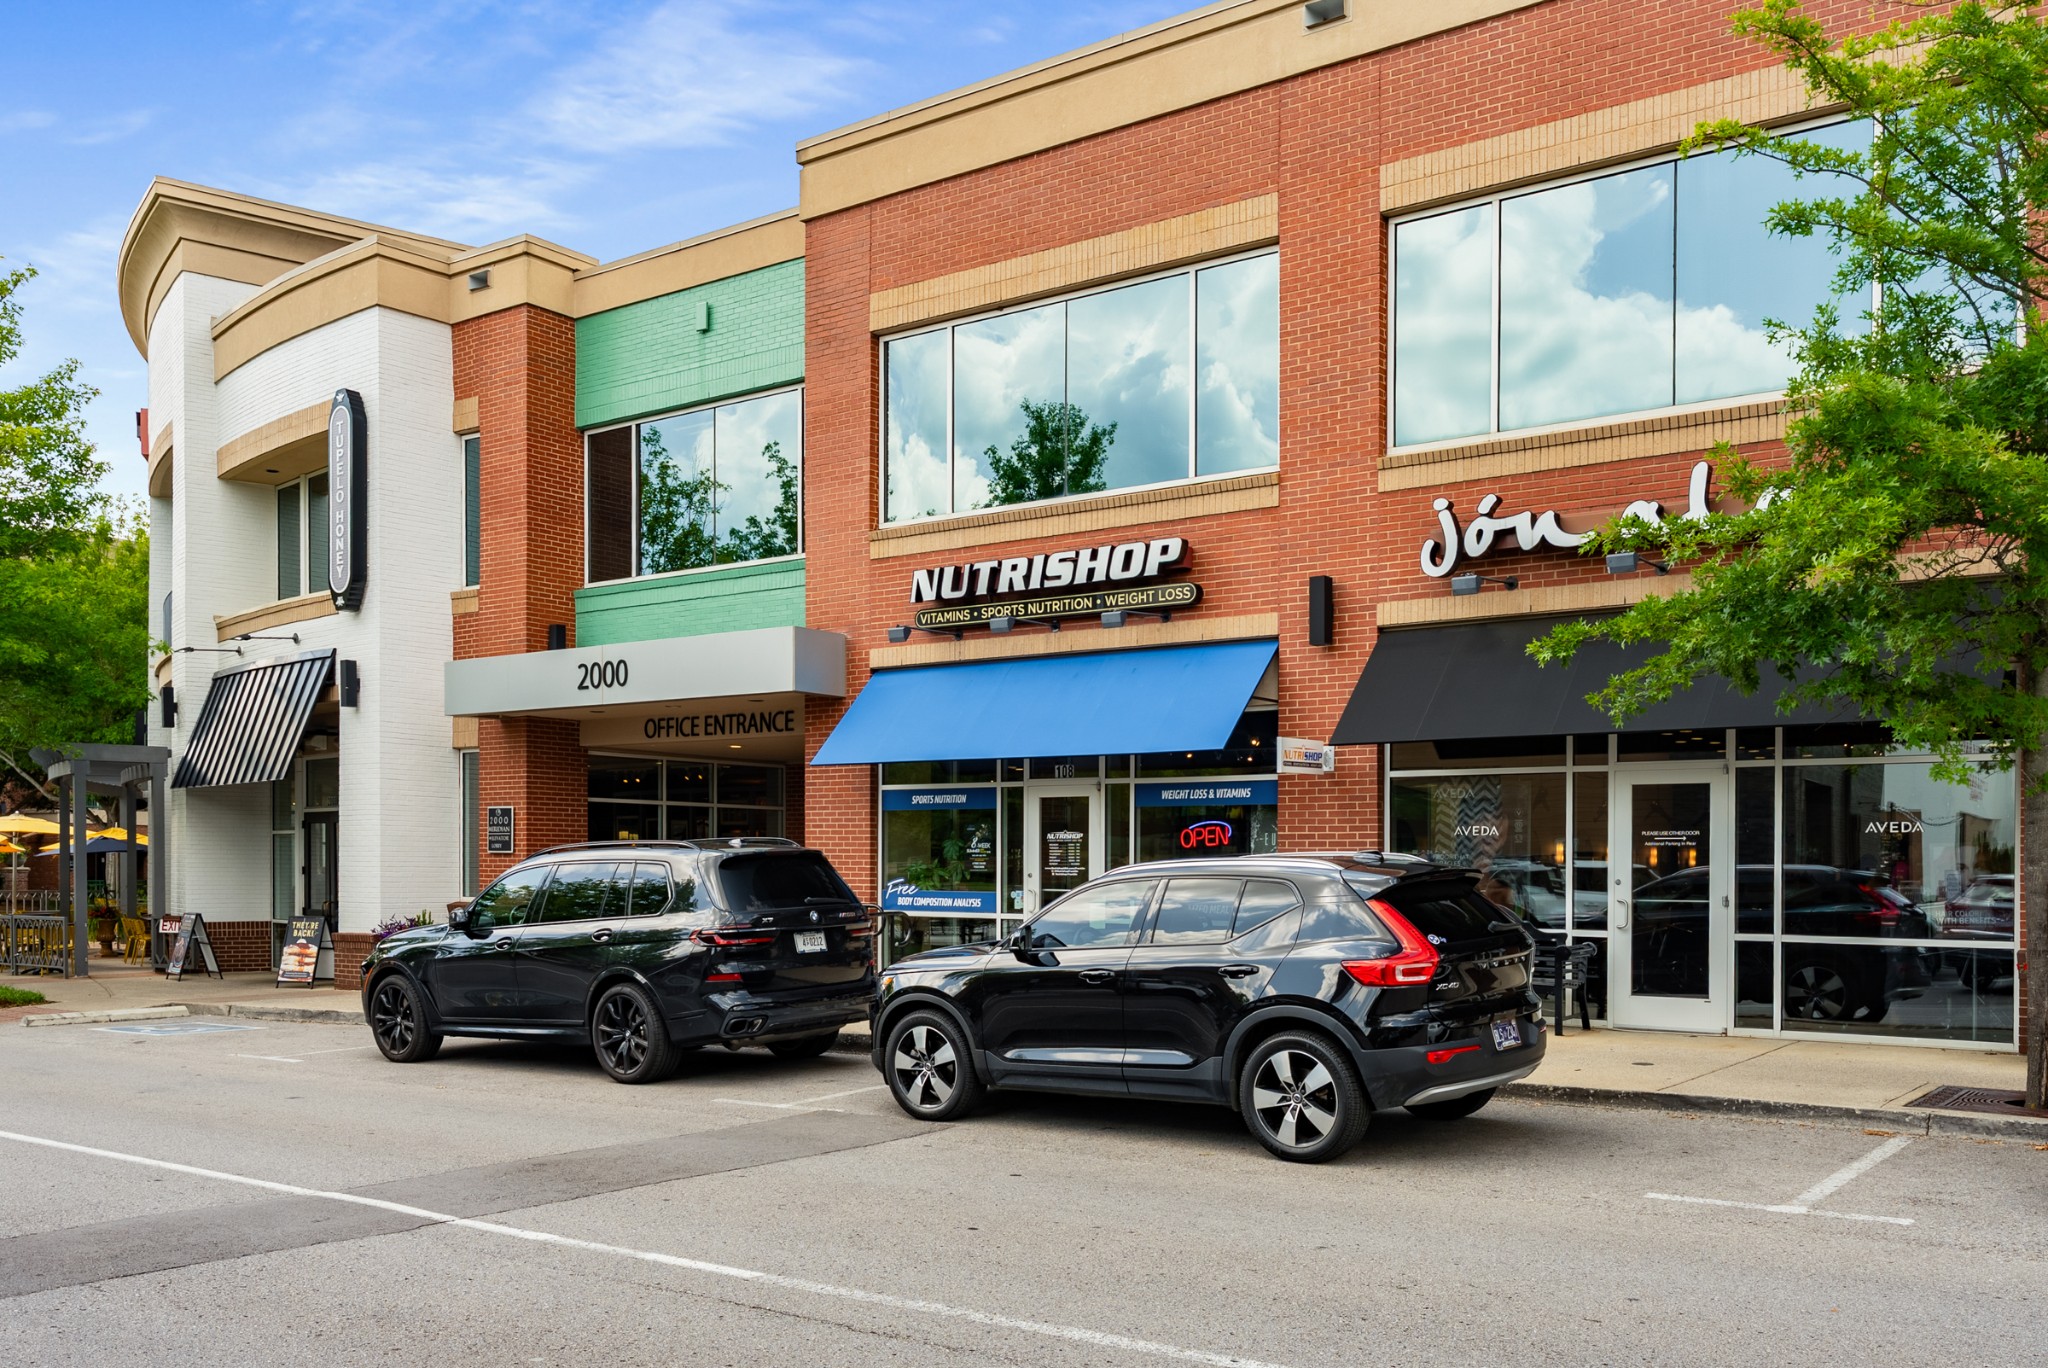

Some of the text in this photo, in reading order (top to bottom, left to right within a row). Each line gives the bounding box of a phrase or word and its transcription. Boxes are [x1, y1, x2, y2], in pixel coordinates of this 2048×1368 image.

[335, 421, 345, 578] TUPELO HONEY
[910, 537, 1184, 603] NUTRISHOP
[919, 586, 1192, 625] VITAMINS SPORTS NUTRITION WEIGHT LOSS
[577, 659, 629, 691] 2000
[644, 710, 795, 739] OFFICE ENTRANCE
[1283, 749, 1323, 762] NUTRISHOP
[1056, 765, 1073, 778] 108
[911, 794, 967, 804] SPORTS NUTRITION
[1161, 788, 1251, 800] WEIGHT LOSS & VITAMINS
[1433, 788, 1475, 799] AVEDA
[490, 816, 509, 824] 2000
[1454, 825, 1499, 836] AVEDA
[1865, 821, 1925, 833] AVEDA
[1046, 832, 1084, 840] NUTRISHOP
[1180, 826, 1230, 849] OPEN
[885, 878, 919, 900] Free
[897, 897, 982, 908] BODY COMPOSITION ANALYSIS
